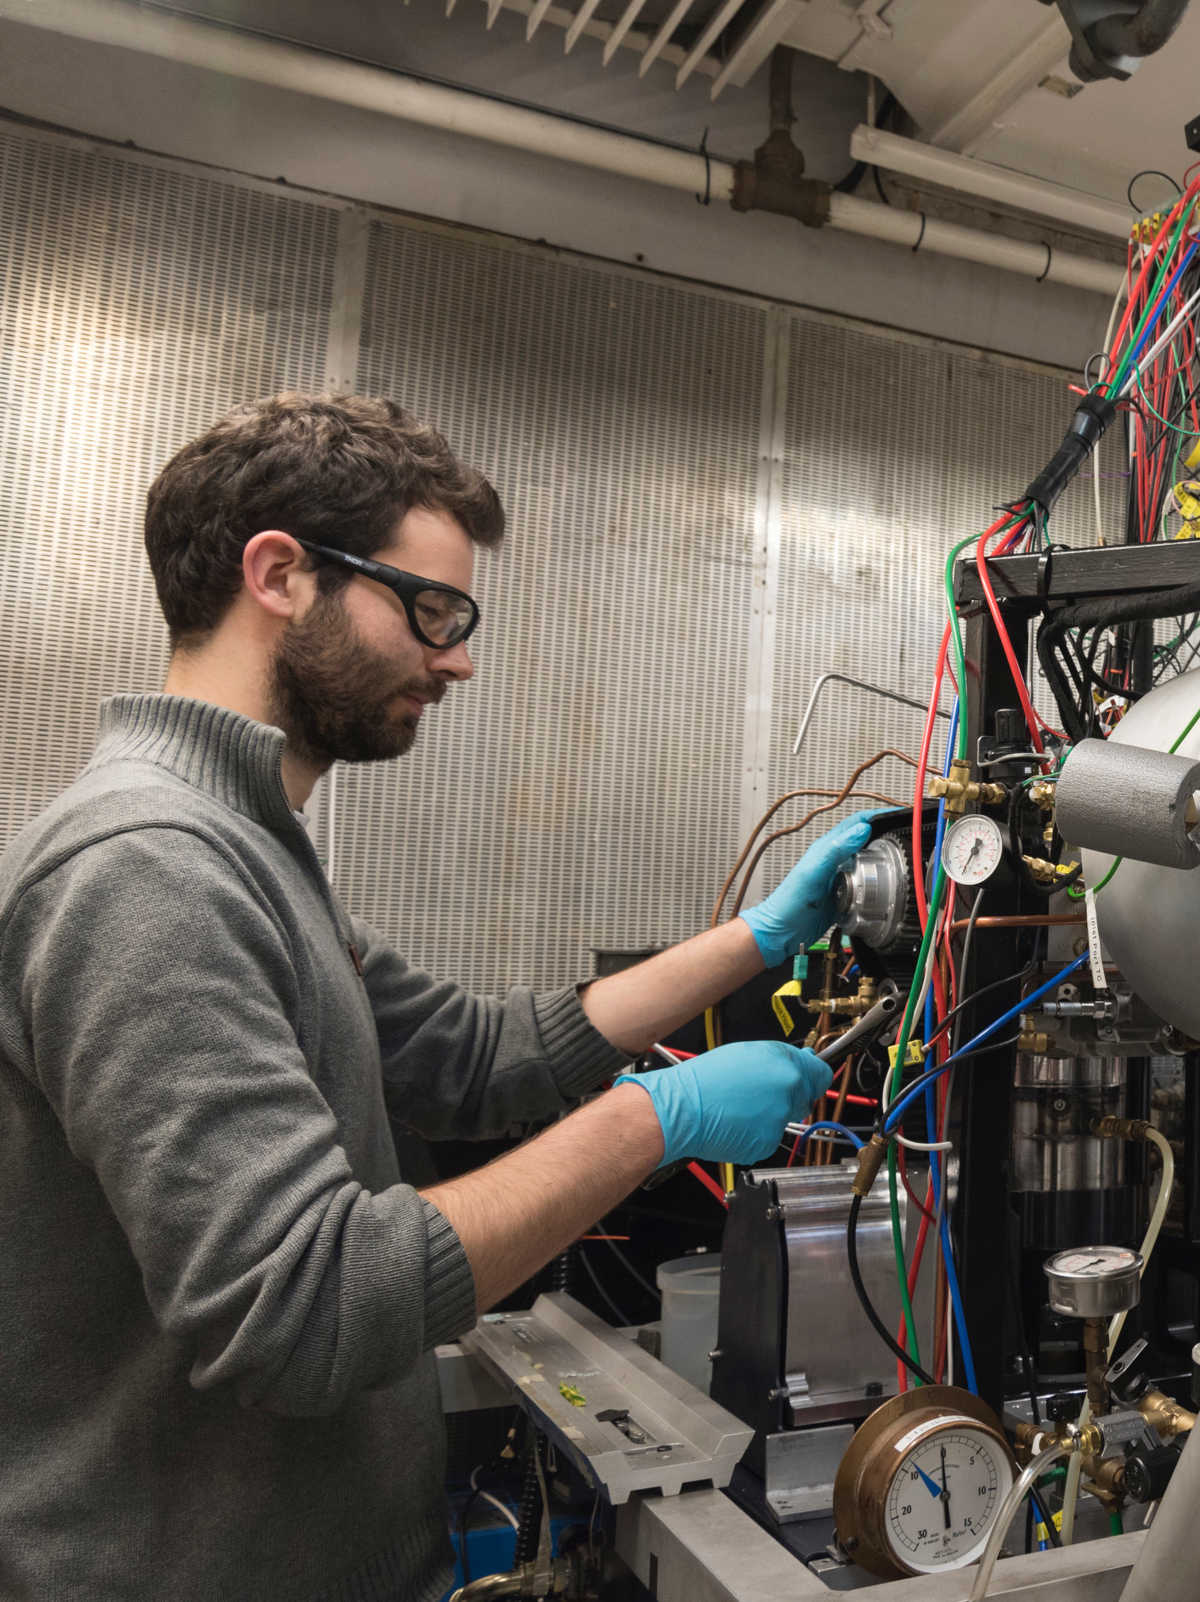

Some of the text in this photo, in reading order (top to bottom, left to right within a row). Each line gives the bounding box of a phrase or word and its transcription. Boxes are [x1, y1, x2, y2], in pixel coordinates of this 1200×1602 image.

[969, 1456, 975, 1465] 5
[910, 1472, 919, 1480] 10
[977, 1486, 987, 1495] 10
[902, 1505, 912, 1515] 20
[964, 1518, 973, 1527] 15
[918, 1529, 927, 1539] 30
